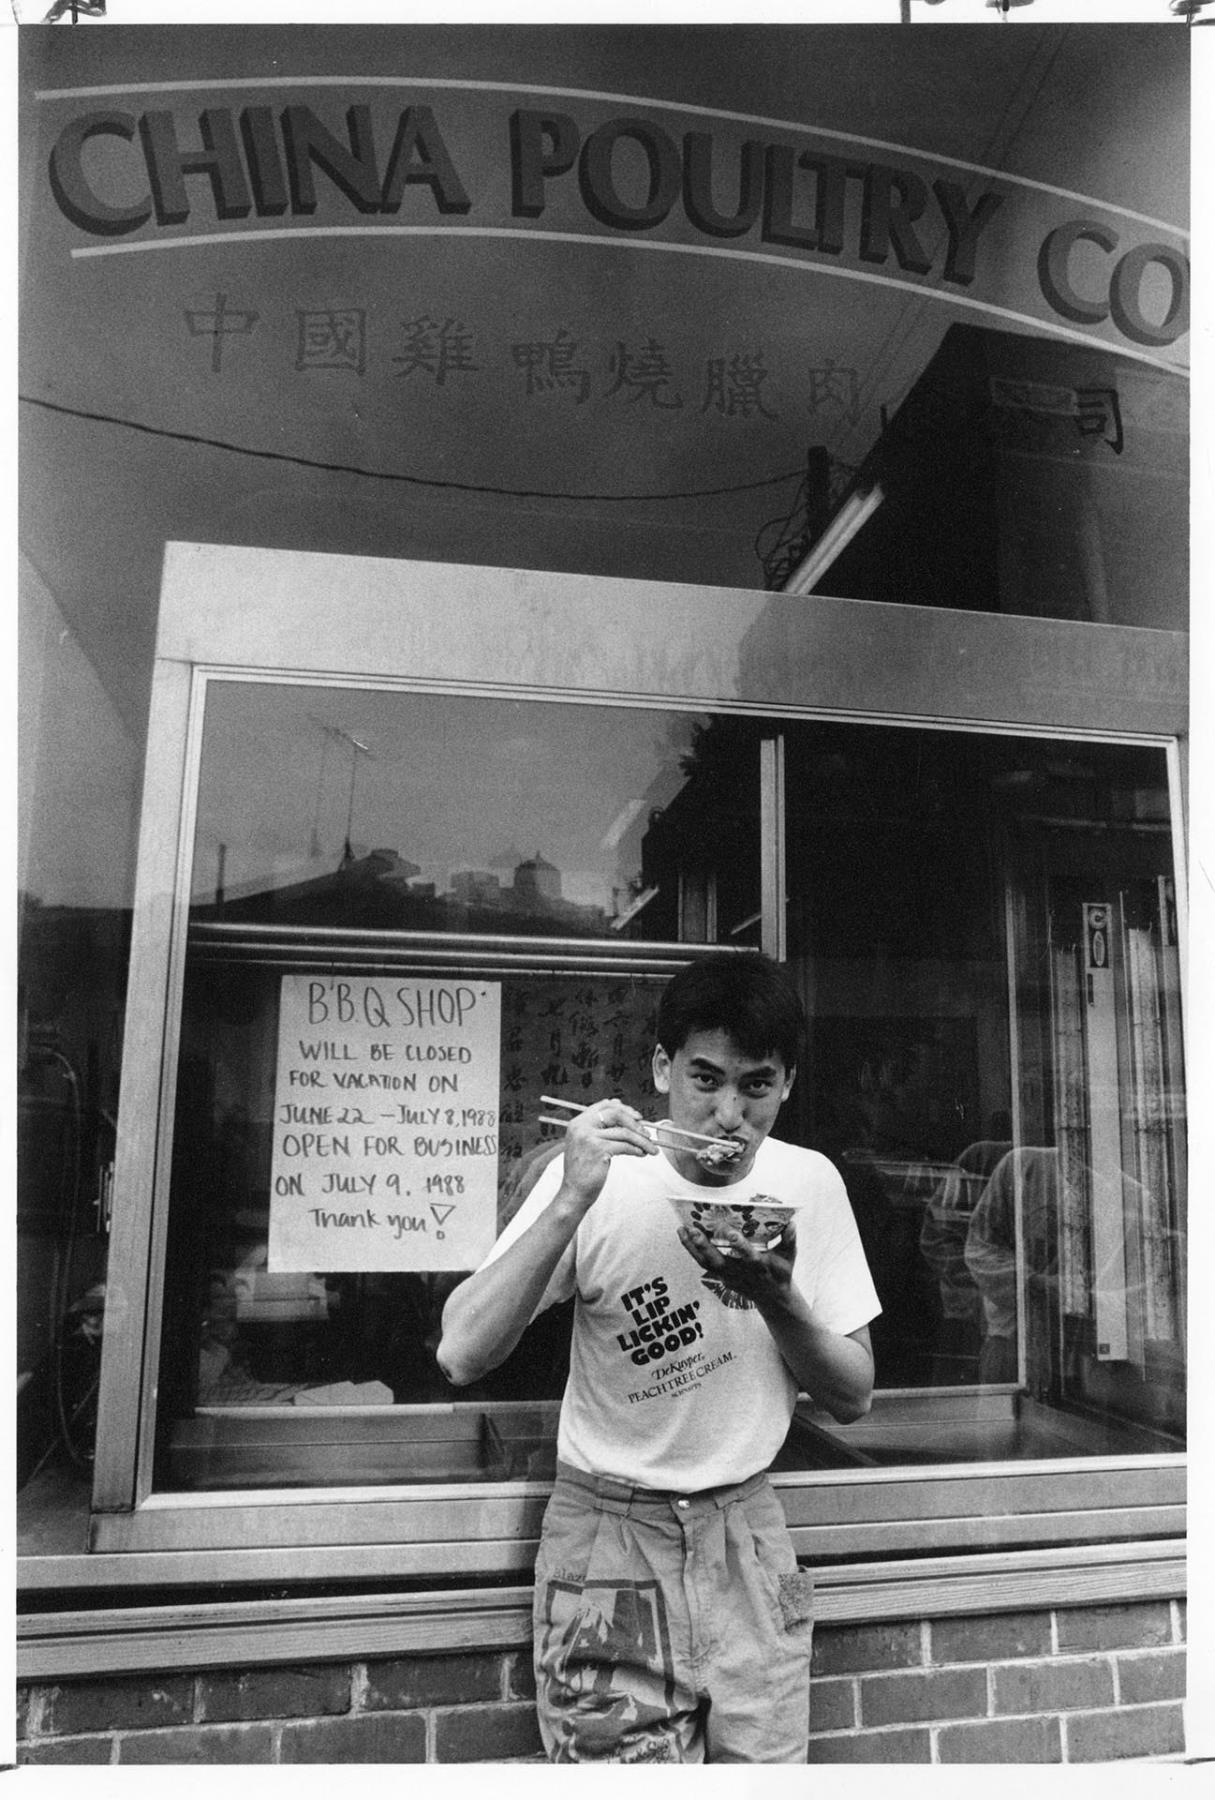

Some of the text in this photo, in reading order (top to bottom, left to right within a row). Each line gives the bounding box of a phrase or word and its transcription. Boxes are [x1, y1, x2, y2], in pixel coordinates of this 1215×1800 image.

[47, 103, 1189, 347] CHINA POULTRY CO
[299, 1040, 472, 1064] WILL BE CLOSED
[289, 1070, 459, 1093] FOR VACATION ON
[280, 1104, 333, 1124] JUNE
[337, 1107, 374, 1124] 22
[282, 1133, 497, 1157] OPEN FOR BUSINESS
[275, 1173, 305, 1197] ON
[322, 1173, 376, 1195] JULY
[426, 1174, 466, 1196] 1988
[308, 1208, 381, 1228] Thank
[620, 1275, 669, 1312] IT'S
[630, 1295, 671, 1327] LIP
[616, 1300, 701, 1352] LICKIN'
[630, 1322, 705, 1366] GOOD!
